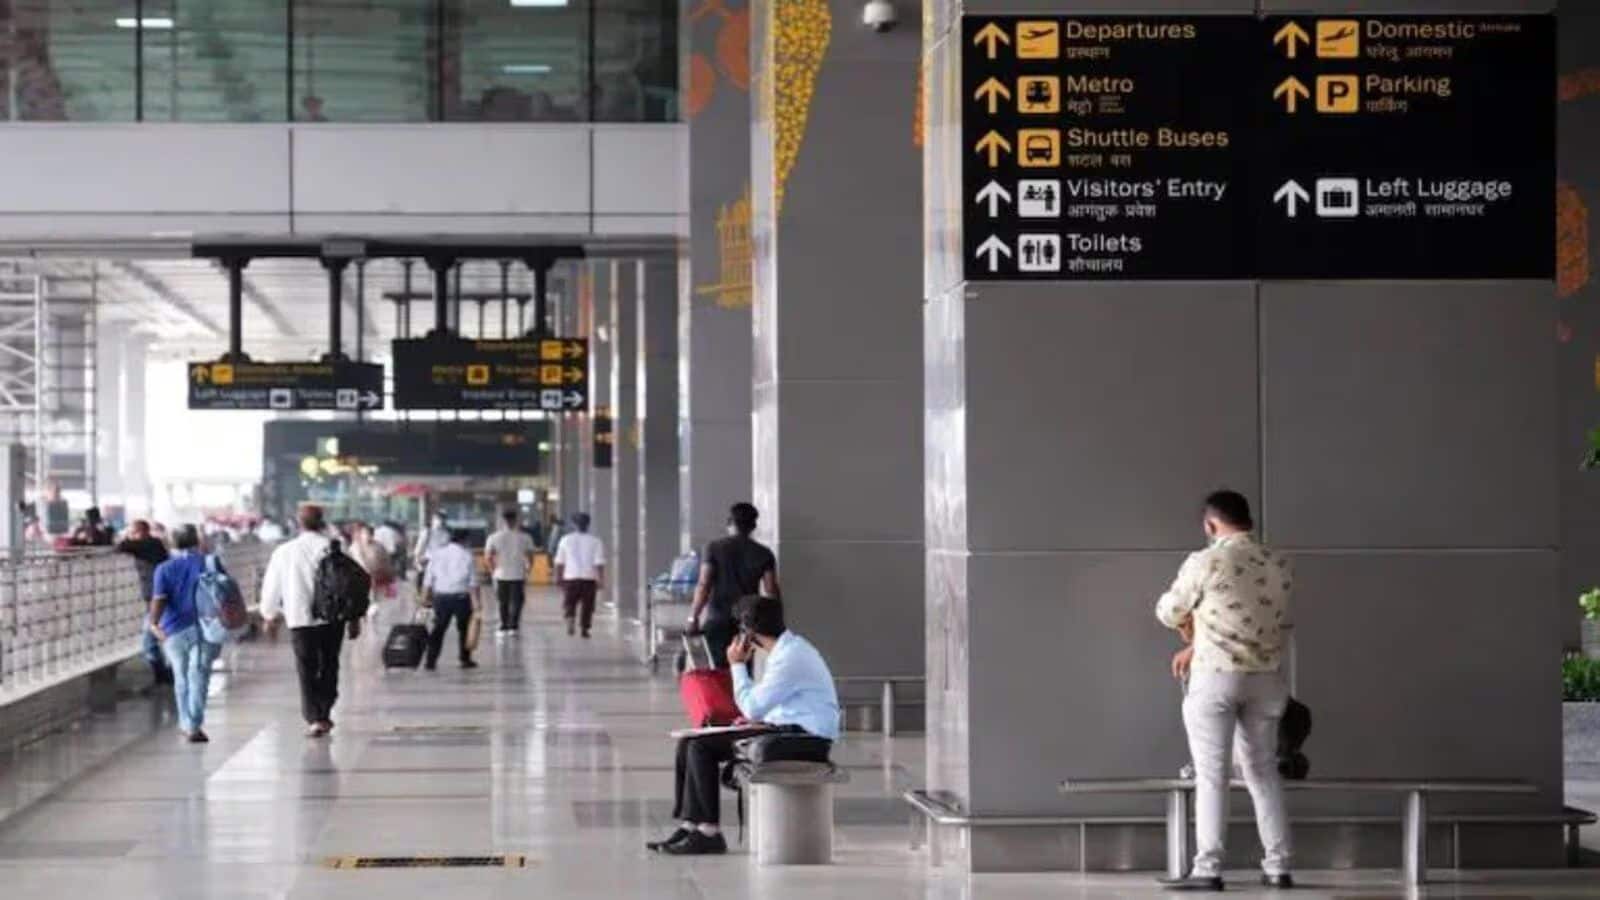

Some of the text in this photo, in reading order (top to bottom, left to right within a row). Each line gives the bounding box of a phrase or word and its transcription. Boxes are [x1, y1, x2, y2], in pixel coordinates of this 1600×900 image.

[1066, 21, 1196, 43] Departures
[1366, 19, 1476, 39] Domestic
[1067, 76, 1135, 94] Metro
[1366, 74, 1453, 96] Parking
[1067, 128, 1230, 148] Shuttle Buses
[1167, 179, 1227, 201] Entry
[1366, 177, 1513, 201] Left Luggage
[1066, 233, 1143, 253] Toilets
